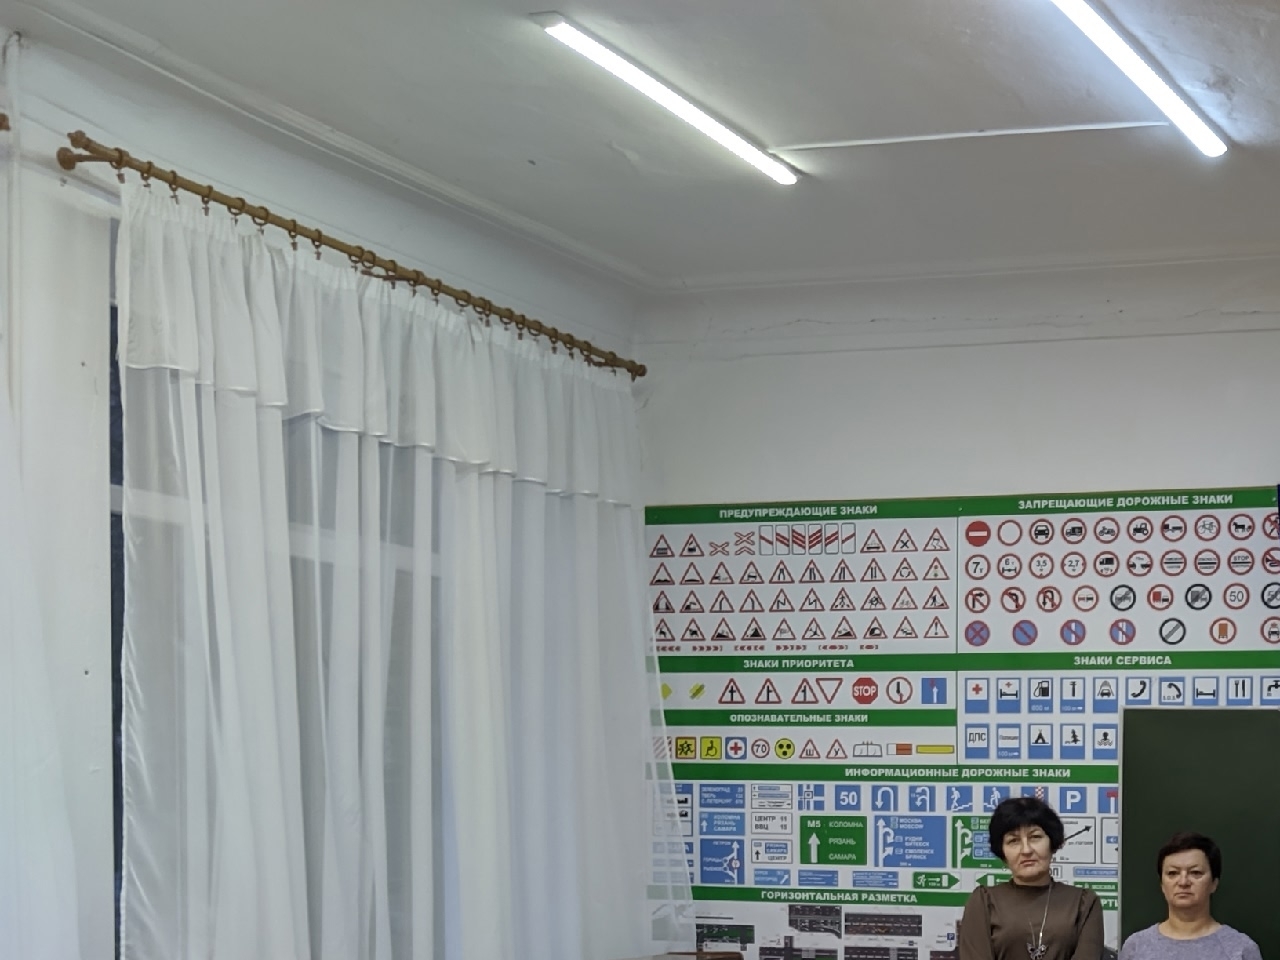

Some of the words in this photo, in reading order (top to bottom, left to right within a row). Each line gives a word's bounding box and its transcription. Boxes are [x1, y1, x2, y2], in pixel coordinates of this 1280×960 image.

[1018, 497, 1113, 510] ЗАПРЕЩАЮЩИЕ
[1116, 495, 1190, 507] ДОРОЖНЫЕ
[1192, 494, 1233, 505] ЗНАКИ
[719, 506, 838, 518] ПРЕДУПРЕЖДАЮЩИЕ
[840, 505, 878, 515] ЗНАКИ
[1229, 590, 1244, 602] 50
[743, 659, 779, 669] ЗНАКИ
[781, 659, 855, 669] ПРИОРИТЕТА
[1074, 656, 1113, 666] ЗНАКИ
[1115, 656, 1172, 665] СЕРВИСА
[853, 686, 877, 697] STOP
[729, 714, 832, 723] ОПОЗНАВАТЕЛЬНЫЕ
[834, 713, 868, 723] ЗНАКИ
[968, 732, 987, 743] ДПС
[754, 744, 767, 753] 70
[845, 768, 959, 778] ИНФОРМАЦИОННЫЕ
[961, 769, 1029, 778] ДОРОЖНЫЕ
[1032, 769, 1071, 777] ЗНАКИ
[840, 791, 858, 806] 50
[761, 890, 858, 902] ГОРИЗОНТАЛЬНАЯ
[861, 893, 918, 903] РАЗМЕТКА
